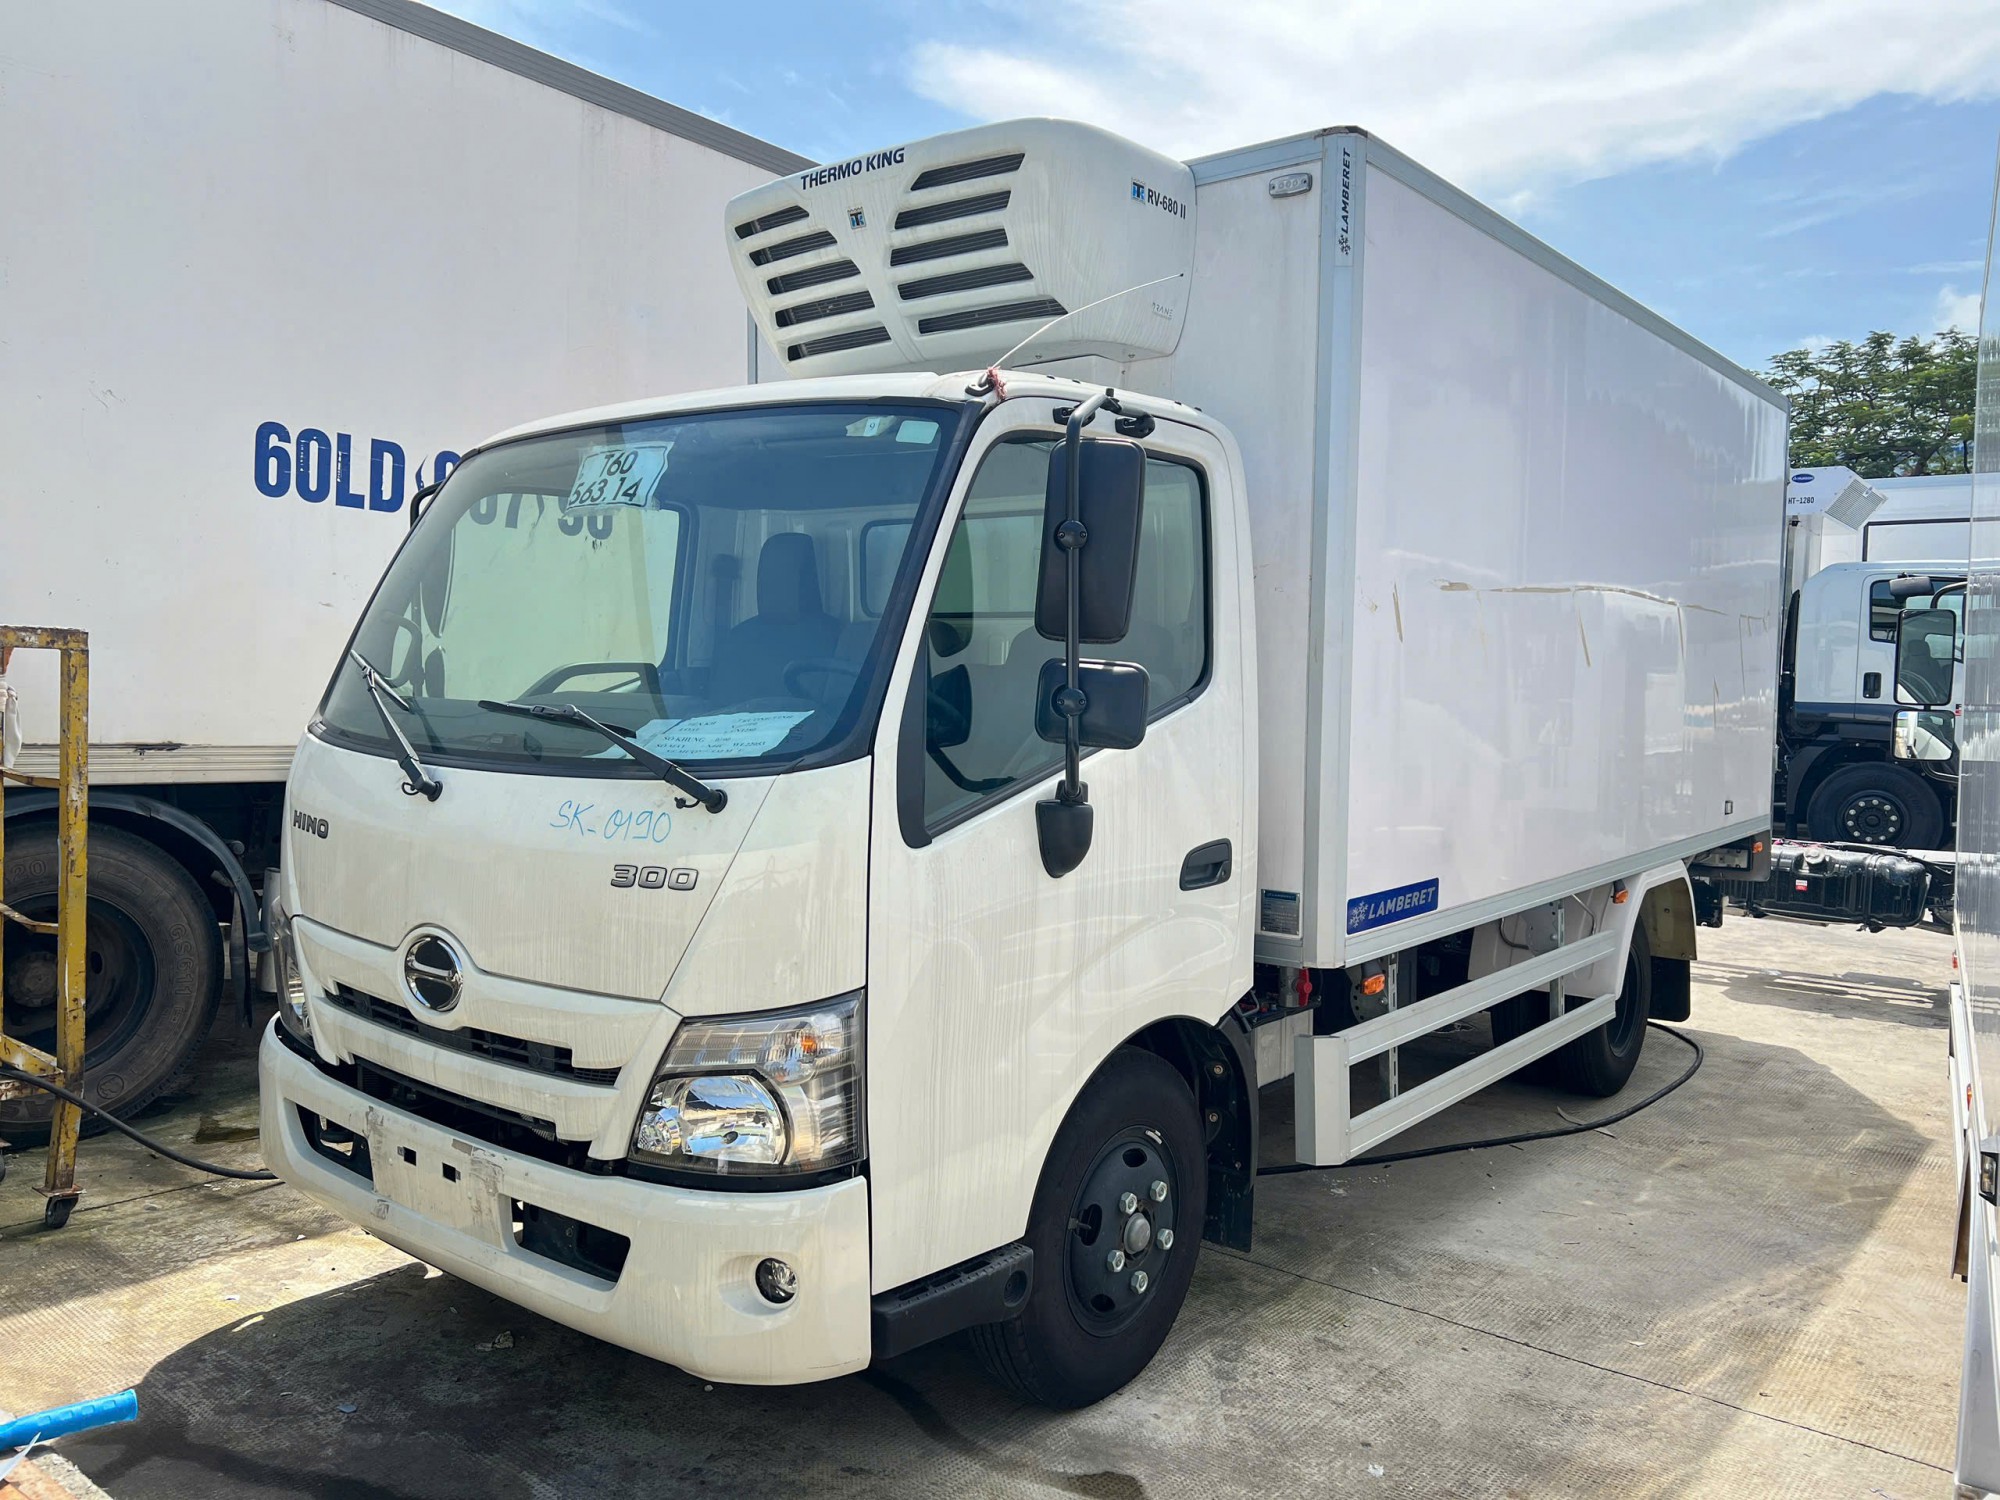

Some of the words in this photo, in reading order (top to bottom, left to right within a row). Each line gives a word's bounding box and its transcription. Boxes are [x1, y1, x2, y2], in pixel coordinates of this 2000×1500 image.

[800, 160, 862, 190] THERMO
[866, 147, 905, 172] KING
[1147, 188, 1178, 216] RV-680
[1180, 203, 1186, 220] II
[1341, 147, 1351, 234] LAMBERET
[254, 421, 405, 513] 60LD
[568, 476, 644, 506] 563.14
[293, 809, 329, 839] HINO
[610, 864, 699, 891] 300
[1368, 886, 1436, 920] LAMBERET
